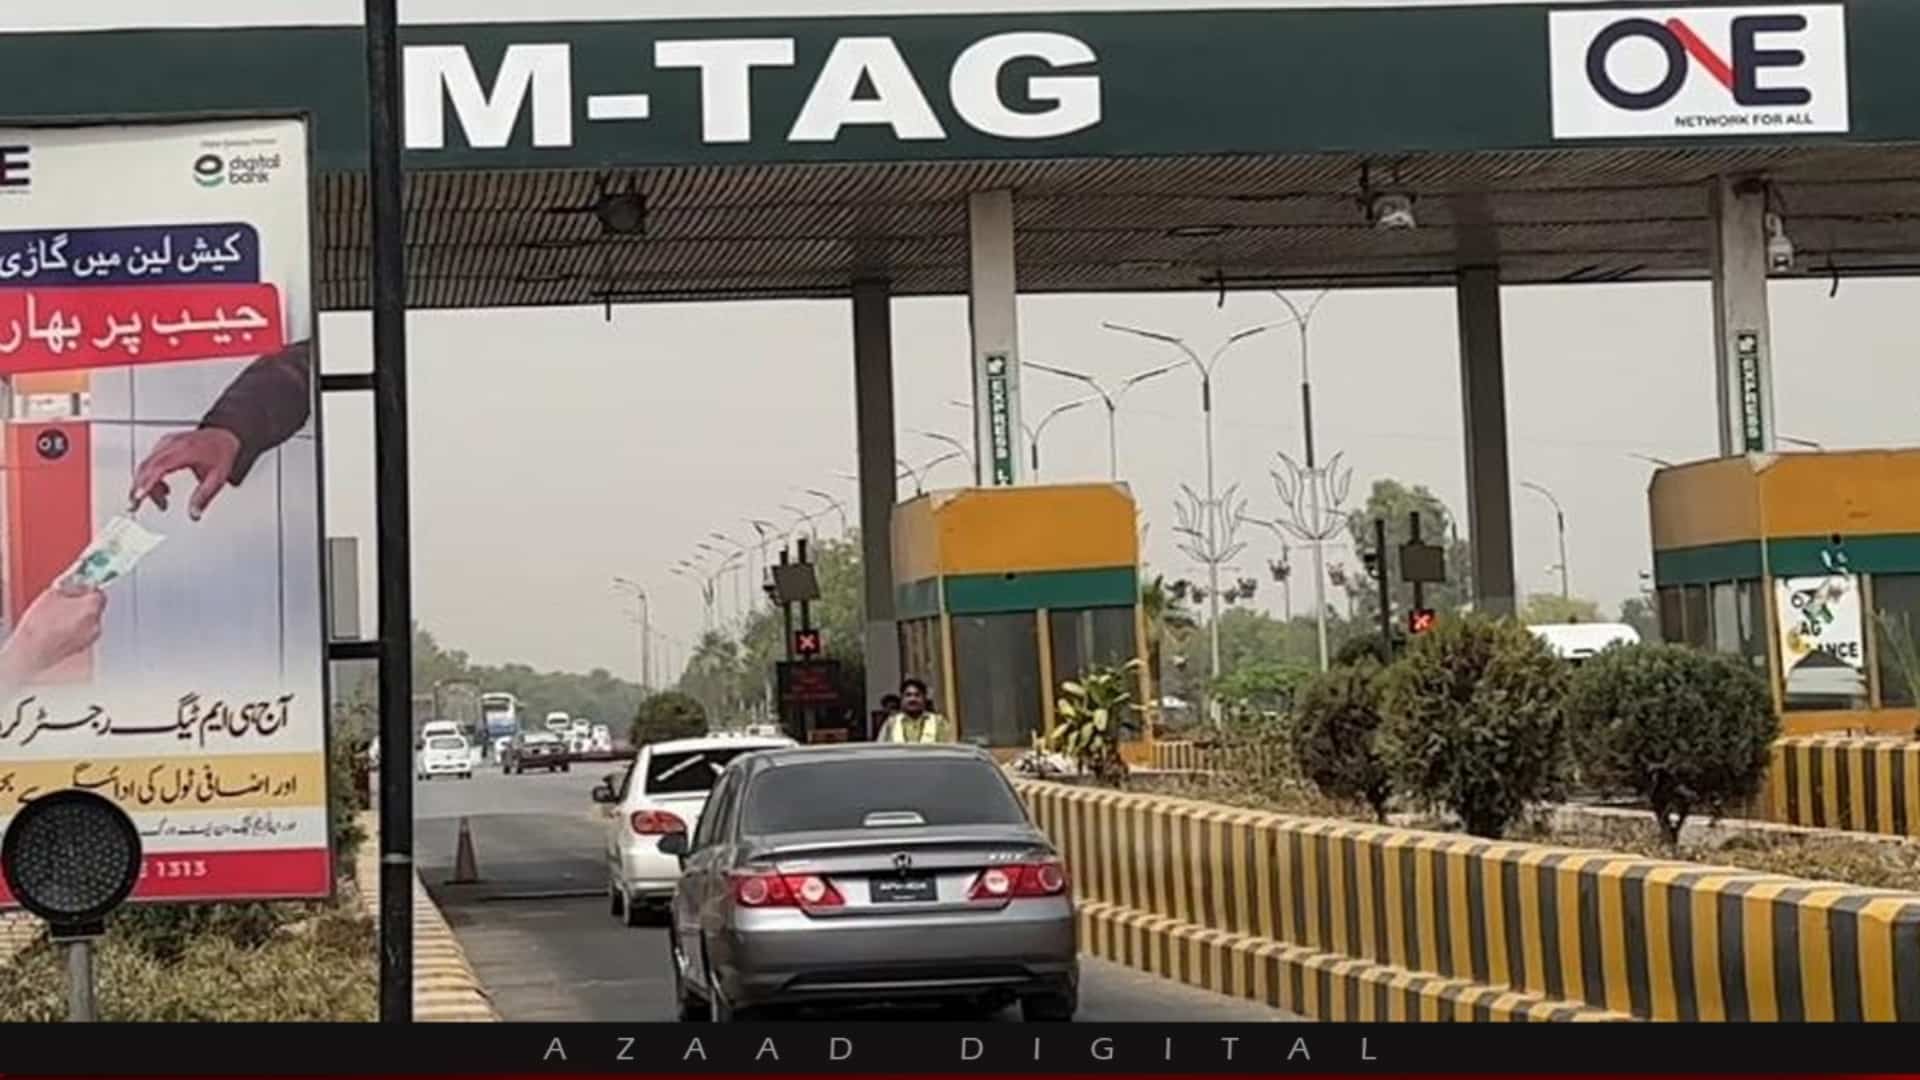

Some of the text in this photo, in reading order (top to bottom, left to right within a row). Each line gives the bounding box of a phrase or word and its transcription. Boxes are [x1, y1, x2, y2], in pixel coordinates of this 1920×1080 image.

[402, 31, 1102, 149] M-TAG
[1675, 112, 1814, 127] NETWORK FOR ALL
[229, 153, 280, 173] digital
[229, 170, 269, 185] bank
[72, 253, 121, 277] میں
[126, 235, 171, 273] لین
[177, 232, 242, 275] کیش
[92, 308, 143, 354] پر
[151, 303, 268, 346] جیب
[1799, 620, 1822, 637] AG
[272, 774, 297, 797] اور
[156, 860, 207, 878] 1313
